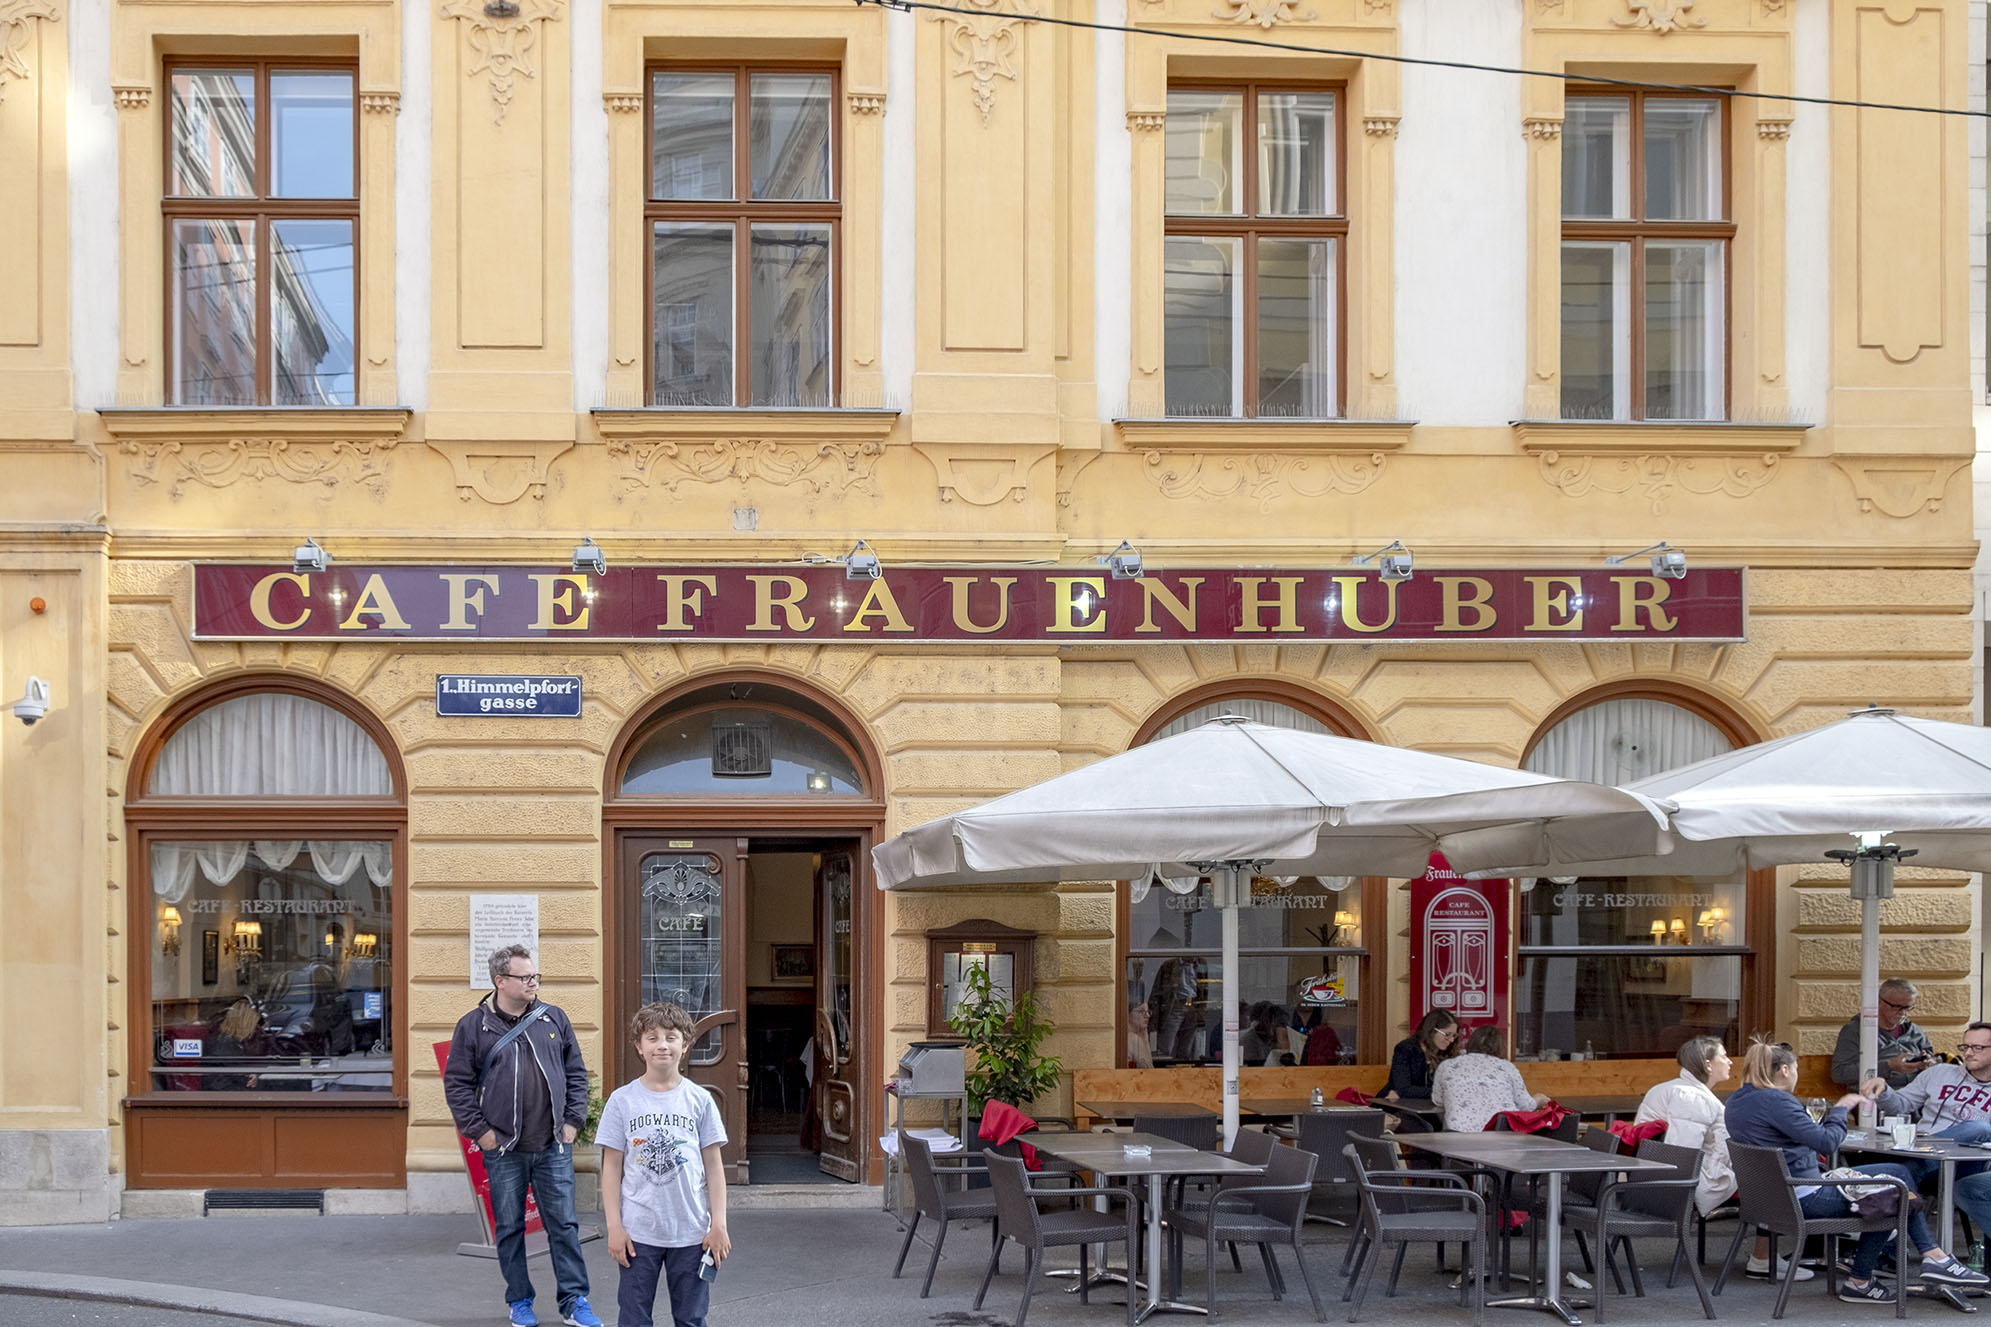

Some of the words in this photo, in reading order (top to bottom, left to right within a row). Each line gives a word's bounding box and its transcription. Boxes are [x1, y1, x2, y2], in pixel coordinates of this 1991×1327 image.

[251, 572, 590, 632] CAFE
[658, 575, 1678, 633] FRAUENHUBER
[479, 697, 538, 712] gasse
[658, 916, 704, 931] CAFE
[178, 1042, 200, 1051] VISA
[629, 1113, 695, 1133] HOGWARTS
